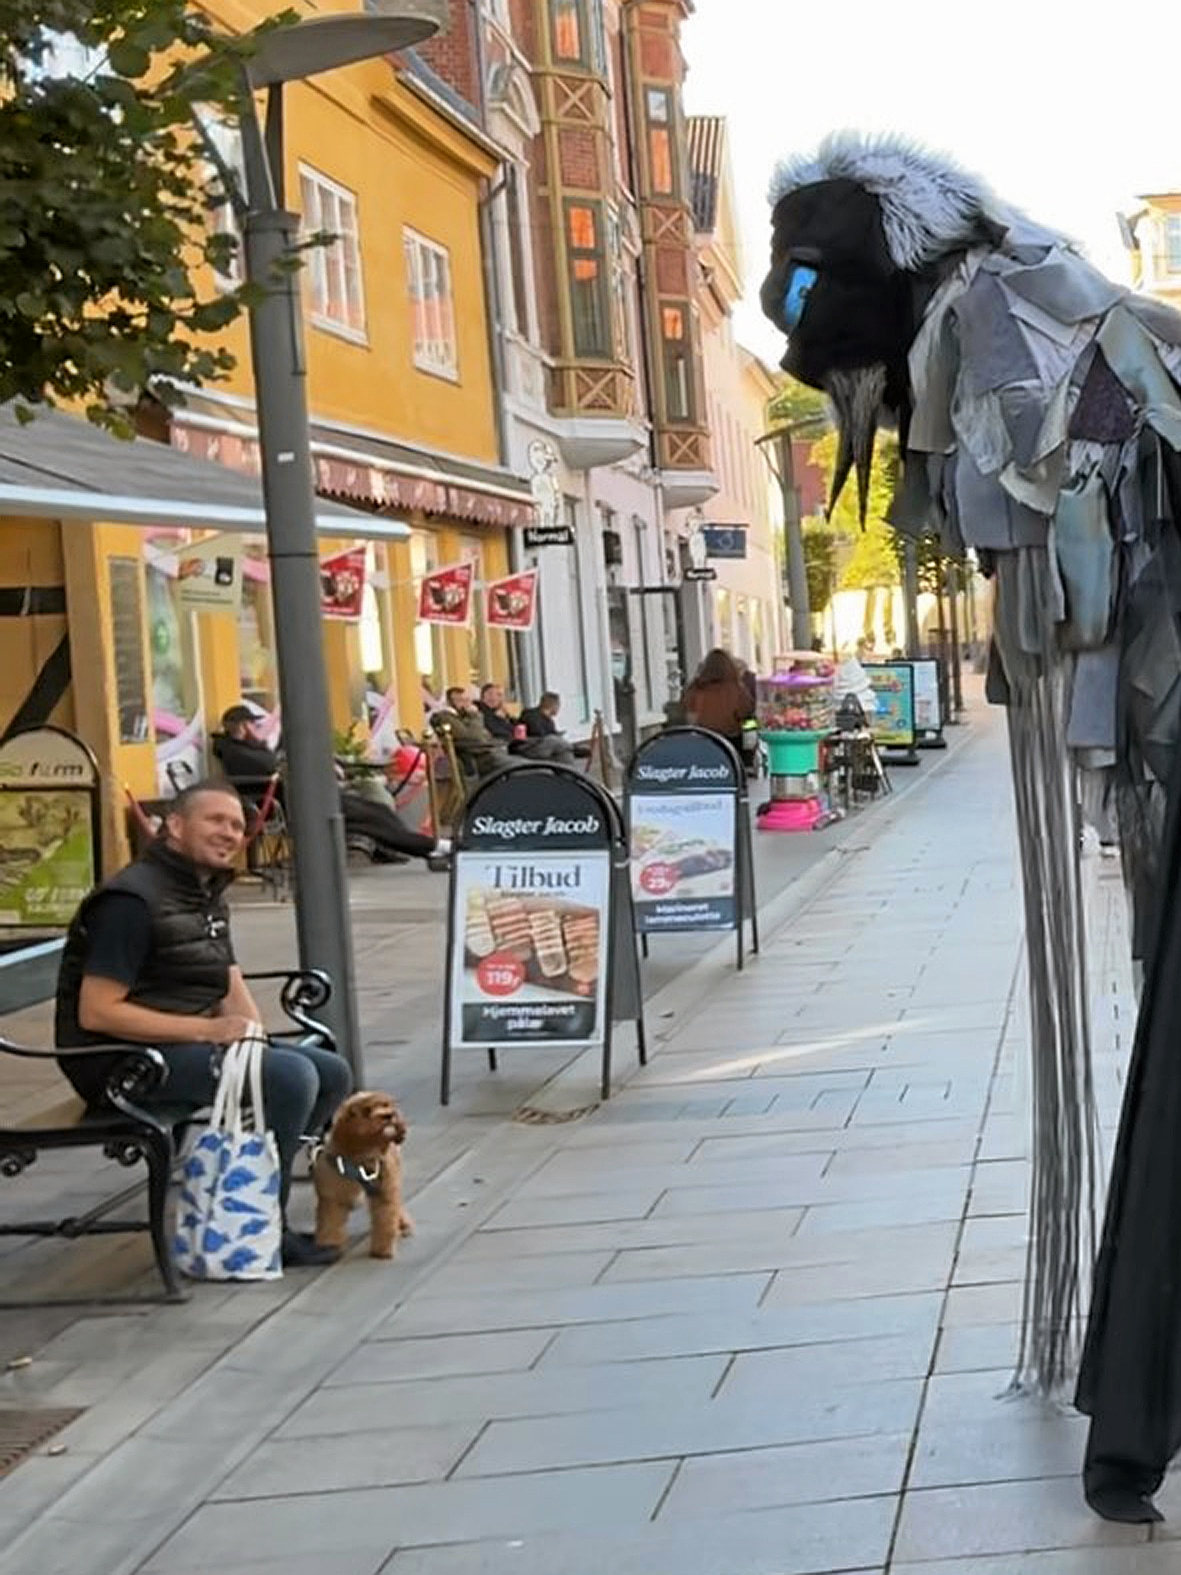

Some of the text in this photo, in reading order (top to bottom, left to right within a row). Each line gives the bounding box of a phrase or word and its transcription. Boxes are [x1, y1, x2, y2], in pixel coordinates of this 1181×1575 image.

[637, 764, 730, 782] Slagter Jacob
[471, 814, 600, 839] Slagter Jacob
[485, 864, 582, 888] Tilbud
